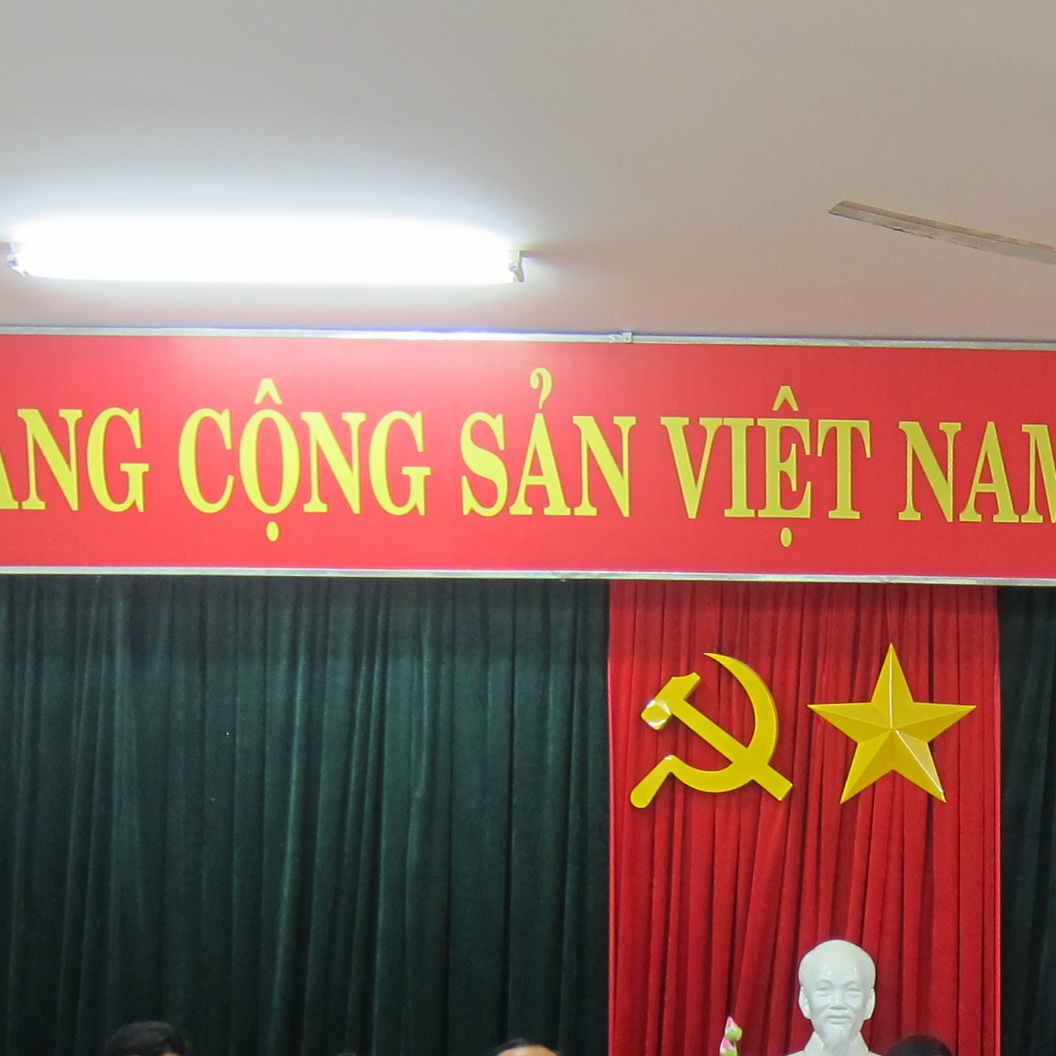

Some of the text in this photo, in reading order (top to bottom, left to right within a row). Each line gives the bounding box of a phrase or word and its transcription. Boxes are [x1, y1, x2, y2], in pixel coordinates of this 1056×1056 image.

[178, 378, 432, 541] CỘNG
[461, 367, 637, 518] SẢN
[660, 385, 871, 547] VIỆT
